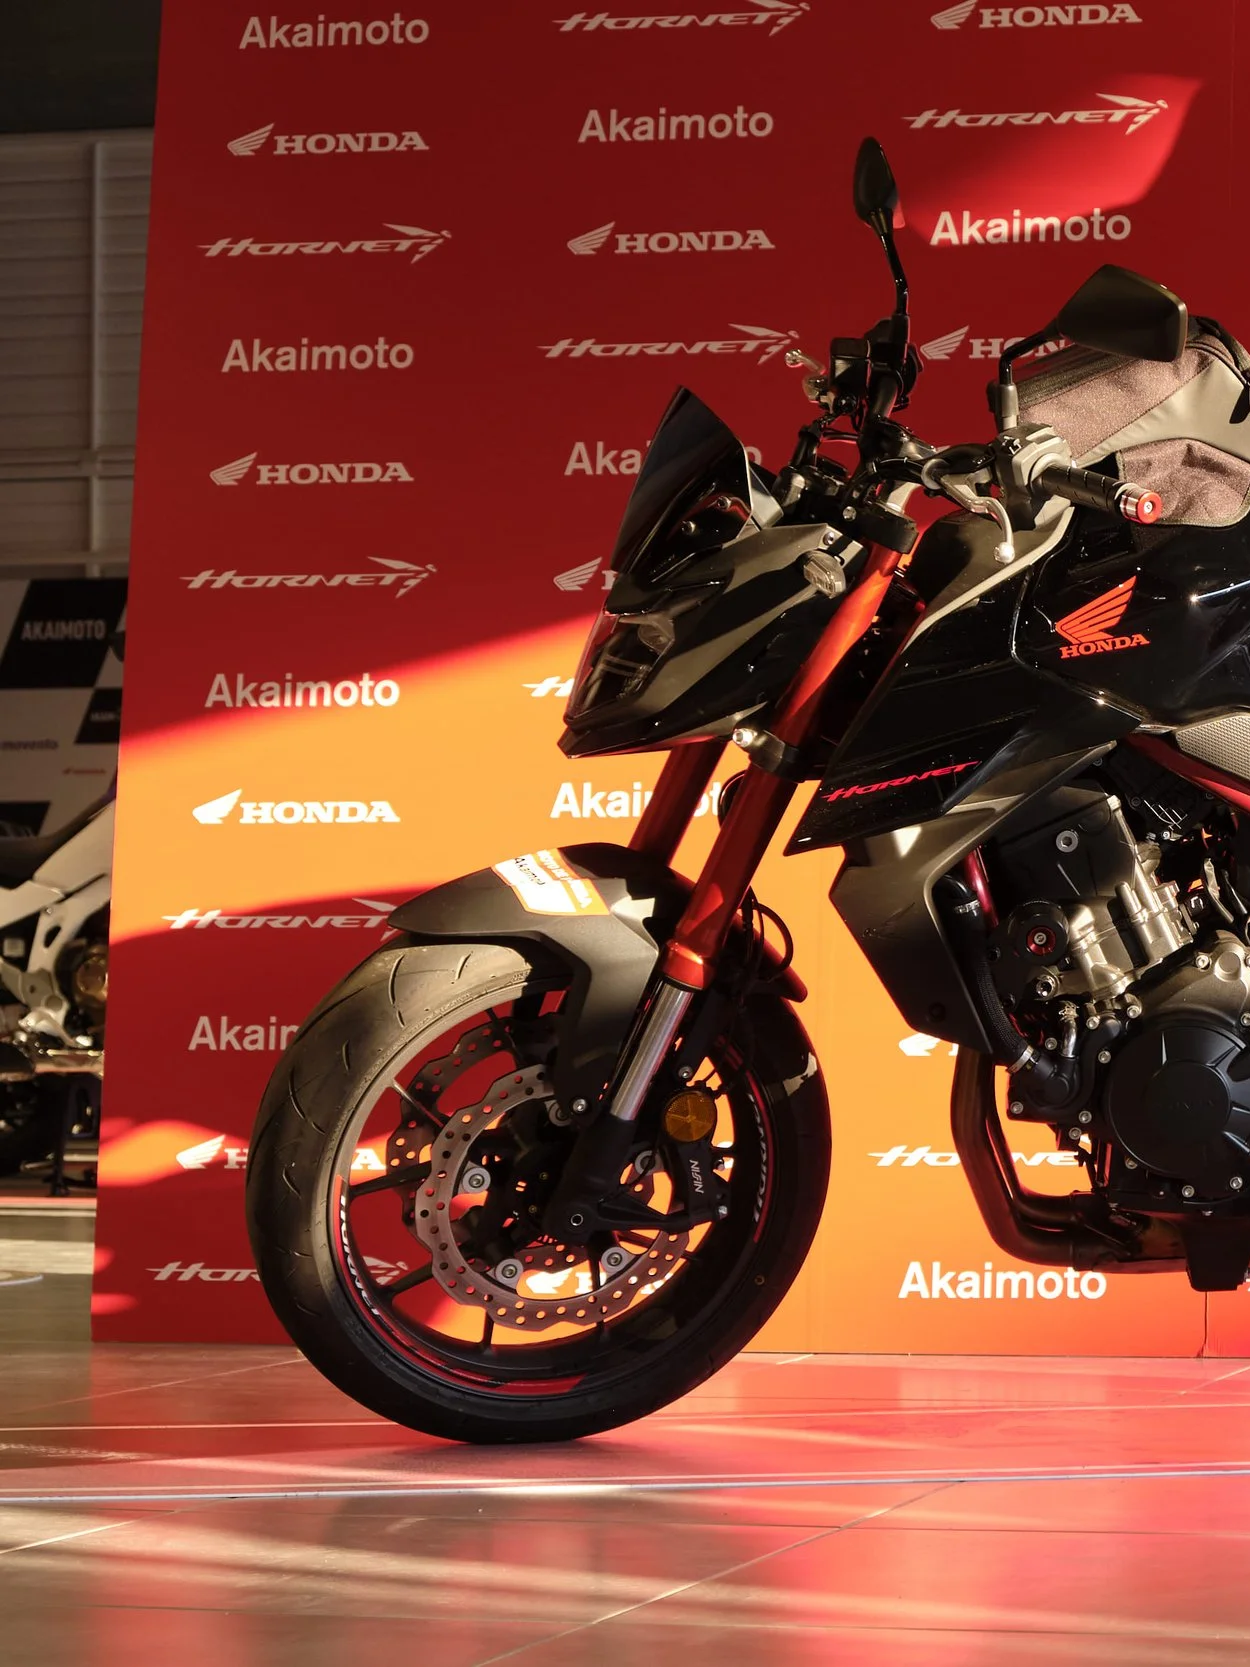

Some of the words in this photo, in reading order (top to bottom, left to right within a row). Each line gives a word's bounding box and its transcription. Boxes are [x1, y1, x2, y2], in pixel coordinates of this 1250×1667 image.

[553, 11, 789, 32] HORNET
[979, 3, 1142, 29] HONDA
[239, 13, 430, 50] Akaimoto
[578, 106, 774, 144] Akaimoto
[904, 108, 1147, 130] HORNET
[273, 131, 430, 155] HONDA
[930, 208, 1132, 247] Akaimoto
[198, 237, 441, 258] HORNET
[615, 229, 776, 255] HONDA
[222, 337, 415, 373] Akaimoto
[538, 338, 778, 360] HORNET
[255, 461, 415, 486] HONDA
[181, 569, 428, 590] HORNET
[22, 619, 106, 641] AKAIMOTO
[1059, 633, 1151, 660] HONDA
[205, 671, 400, 708] Akaimoto
[821, 760, 982, 803] HORNET
[239, 800, 400, 825] HONDA
[899, 1262, 1107, 1301] Akaimoto
